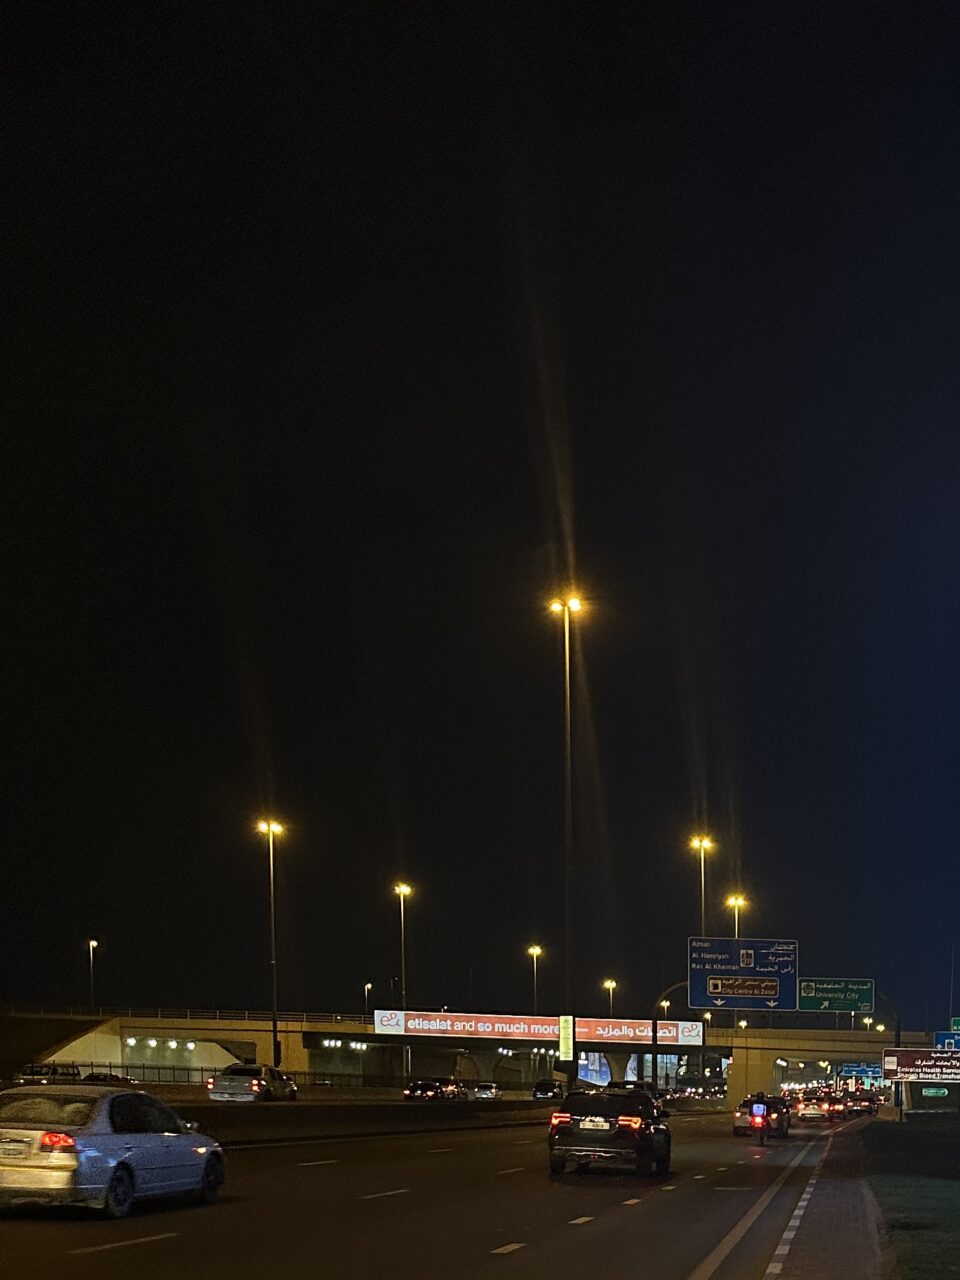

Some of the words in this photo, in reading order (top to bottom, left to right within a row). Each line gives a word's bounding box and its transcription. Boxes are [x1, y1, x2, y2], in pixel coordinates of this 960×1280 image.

[755, 965, 778, 973] الخيمة
[780, 963, 795, 974] رأس
[722, 987, 733, 995] City
[815, 991, 845, 1000] University
[846, 992, 859, 1000] City
[407, 1018, 452, 1030] etisalat
[454, 1020, 475, 1031] and
[477, 1022, 492, 1031] so
[494, 1021, 528, 1033] much
[530, 1024, 560, 1034] more
[595, 1024, 634, 1038] والمزيد
